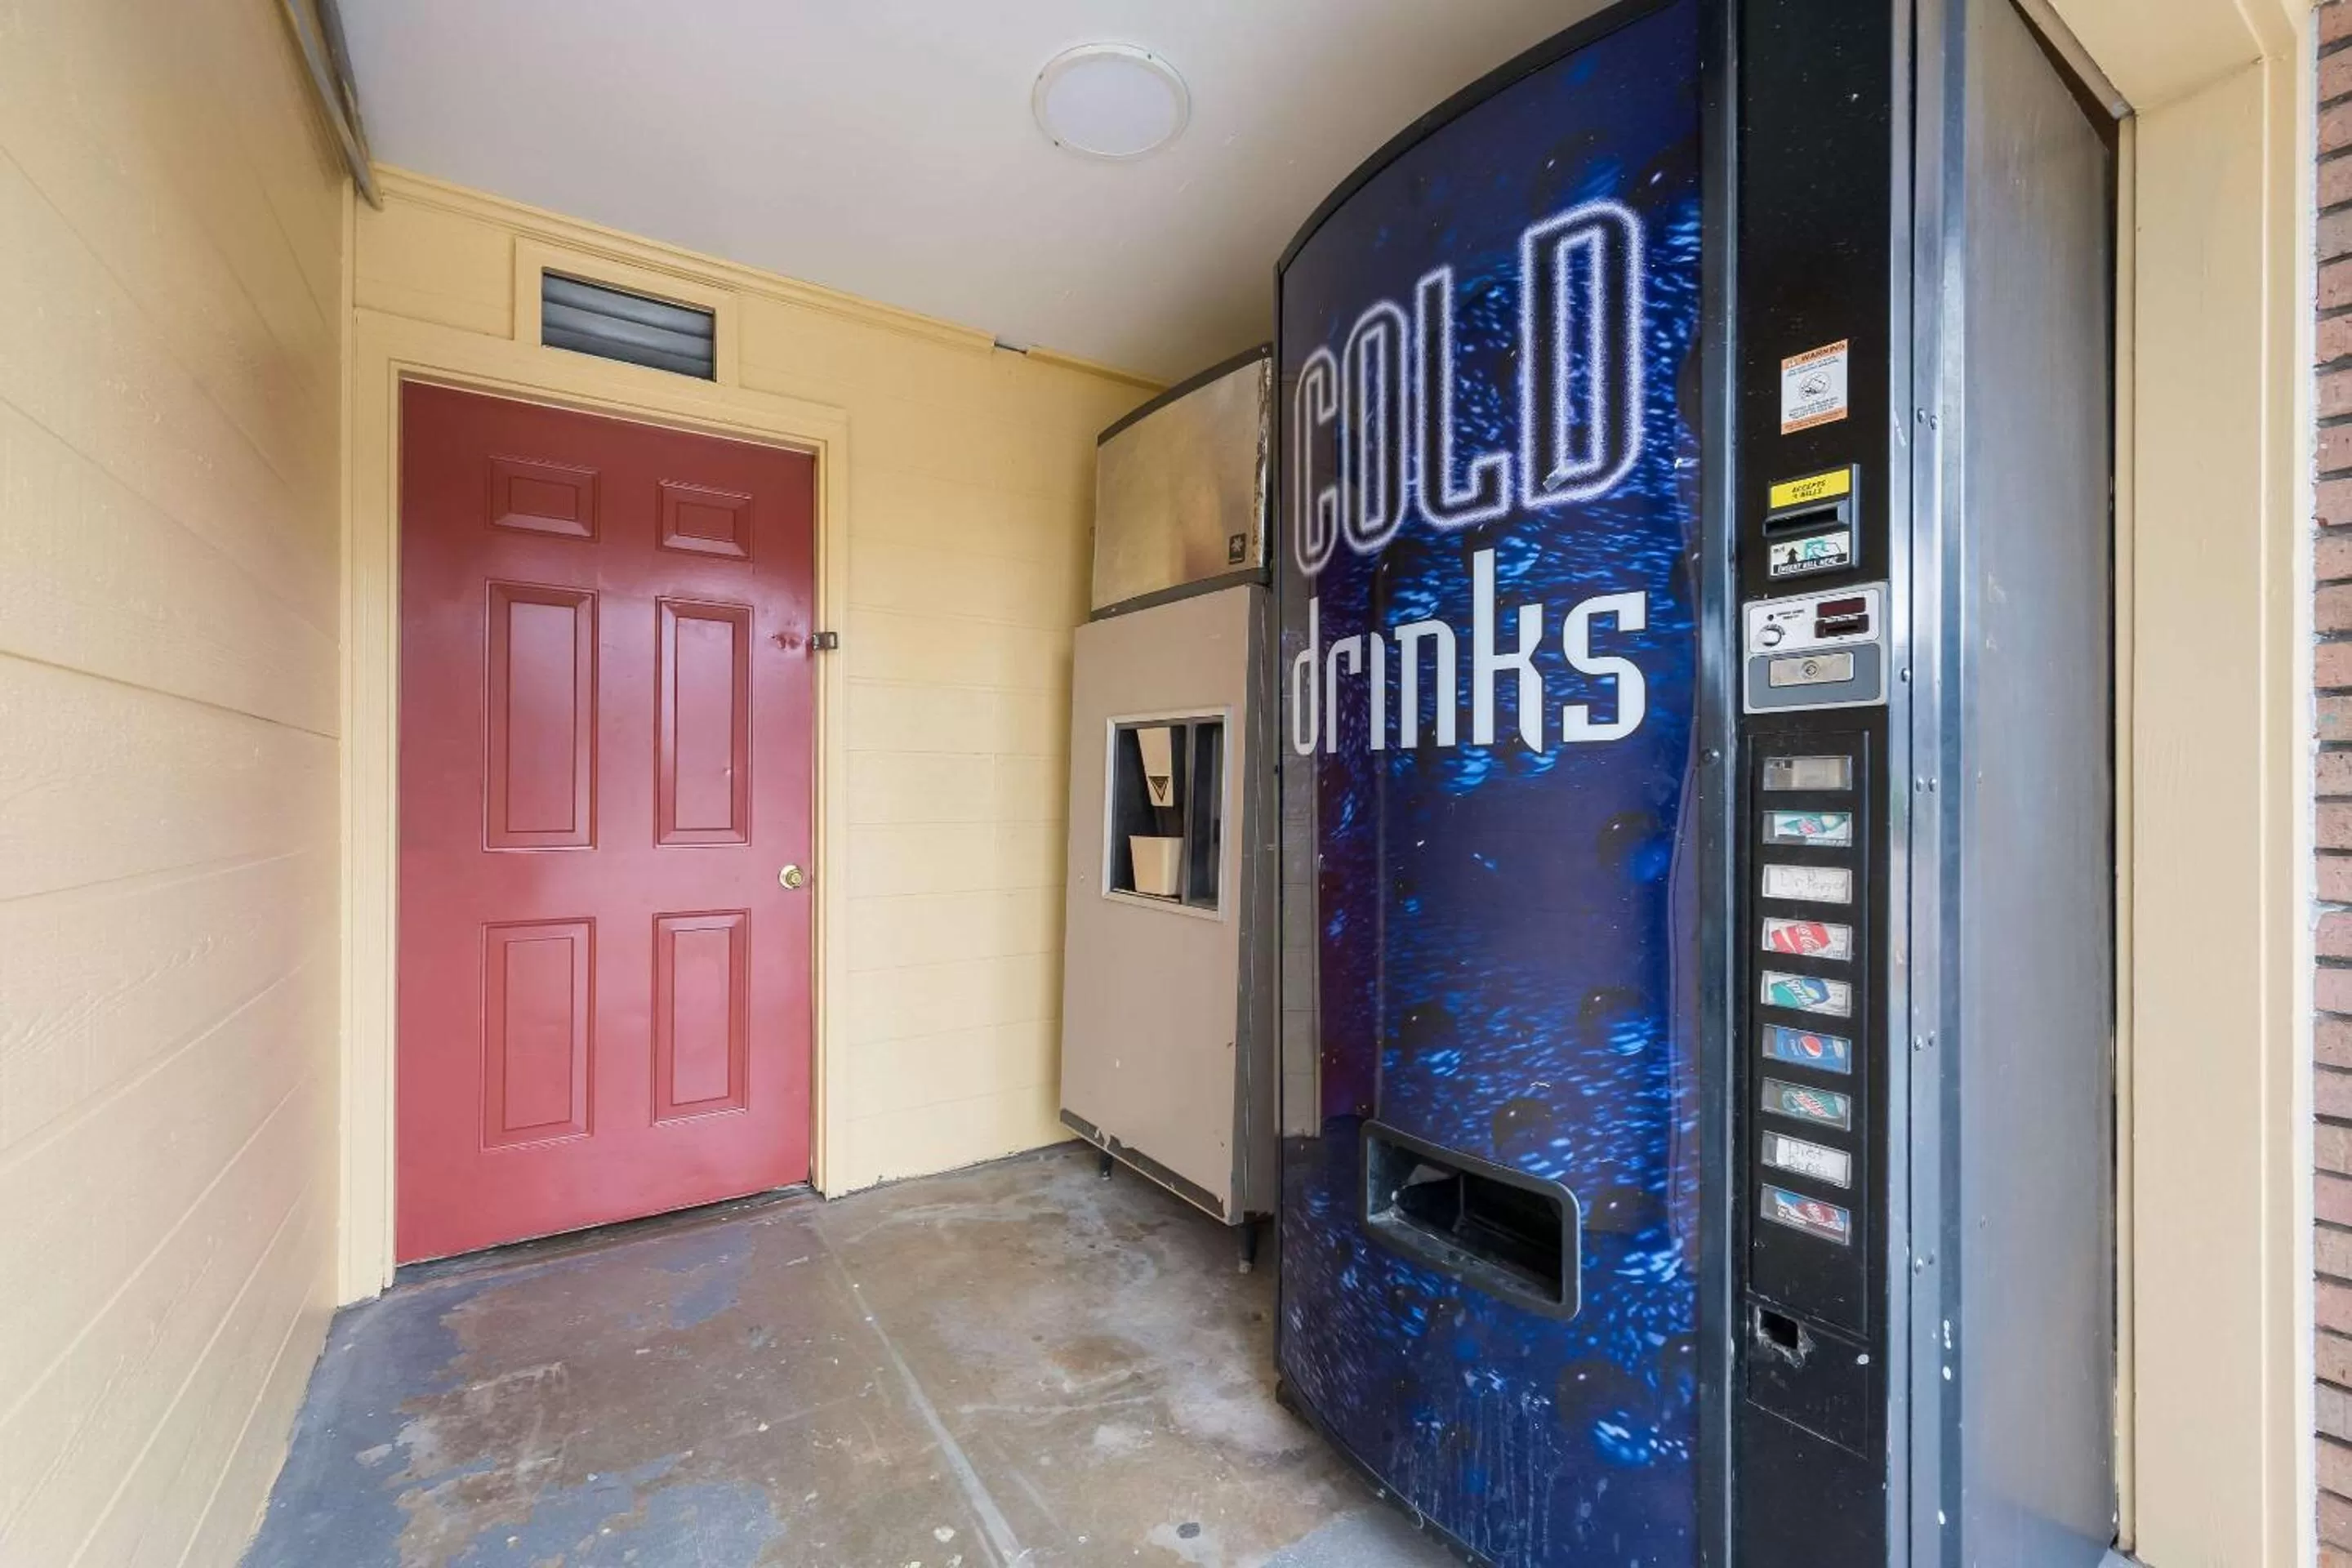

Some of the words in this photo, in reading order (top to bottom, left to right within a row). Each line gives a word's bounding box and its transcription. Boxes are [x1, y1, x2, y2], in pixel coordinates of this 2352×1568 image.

[1294, 198, 1645, 577] COLD
[1801, 343, 1846, 363] WARNING
[1792, 479, 1826, 493] ACCEPTS
[1292, 547, 1646, 755] drinks
